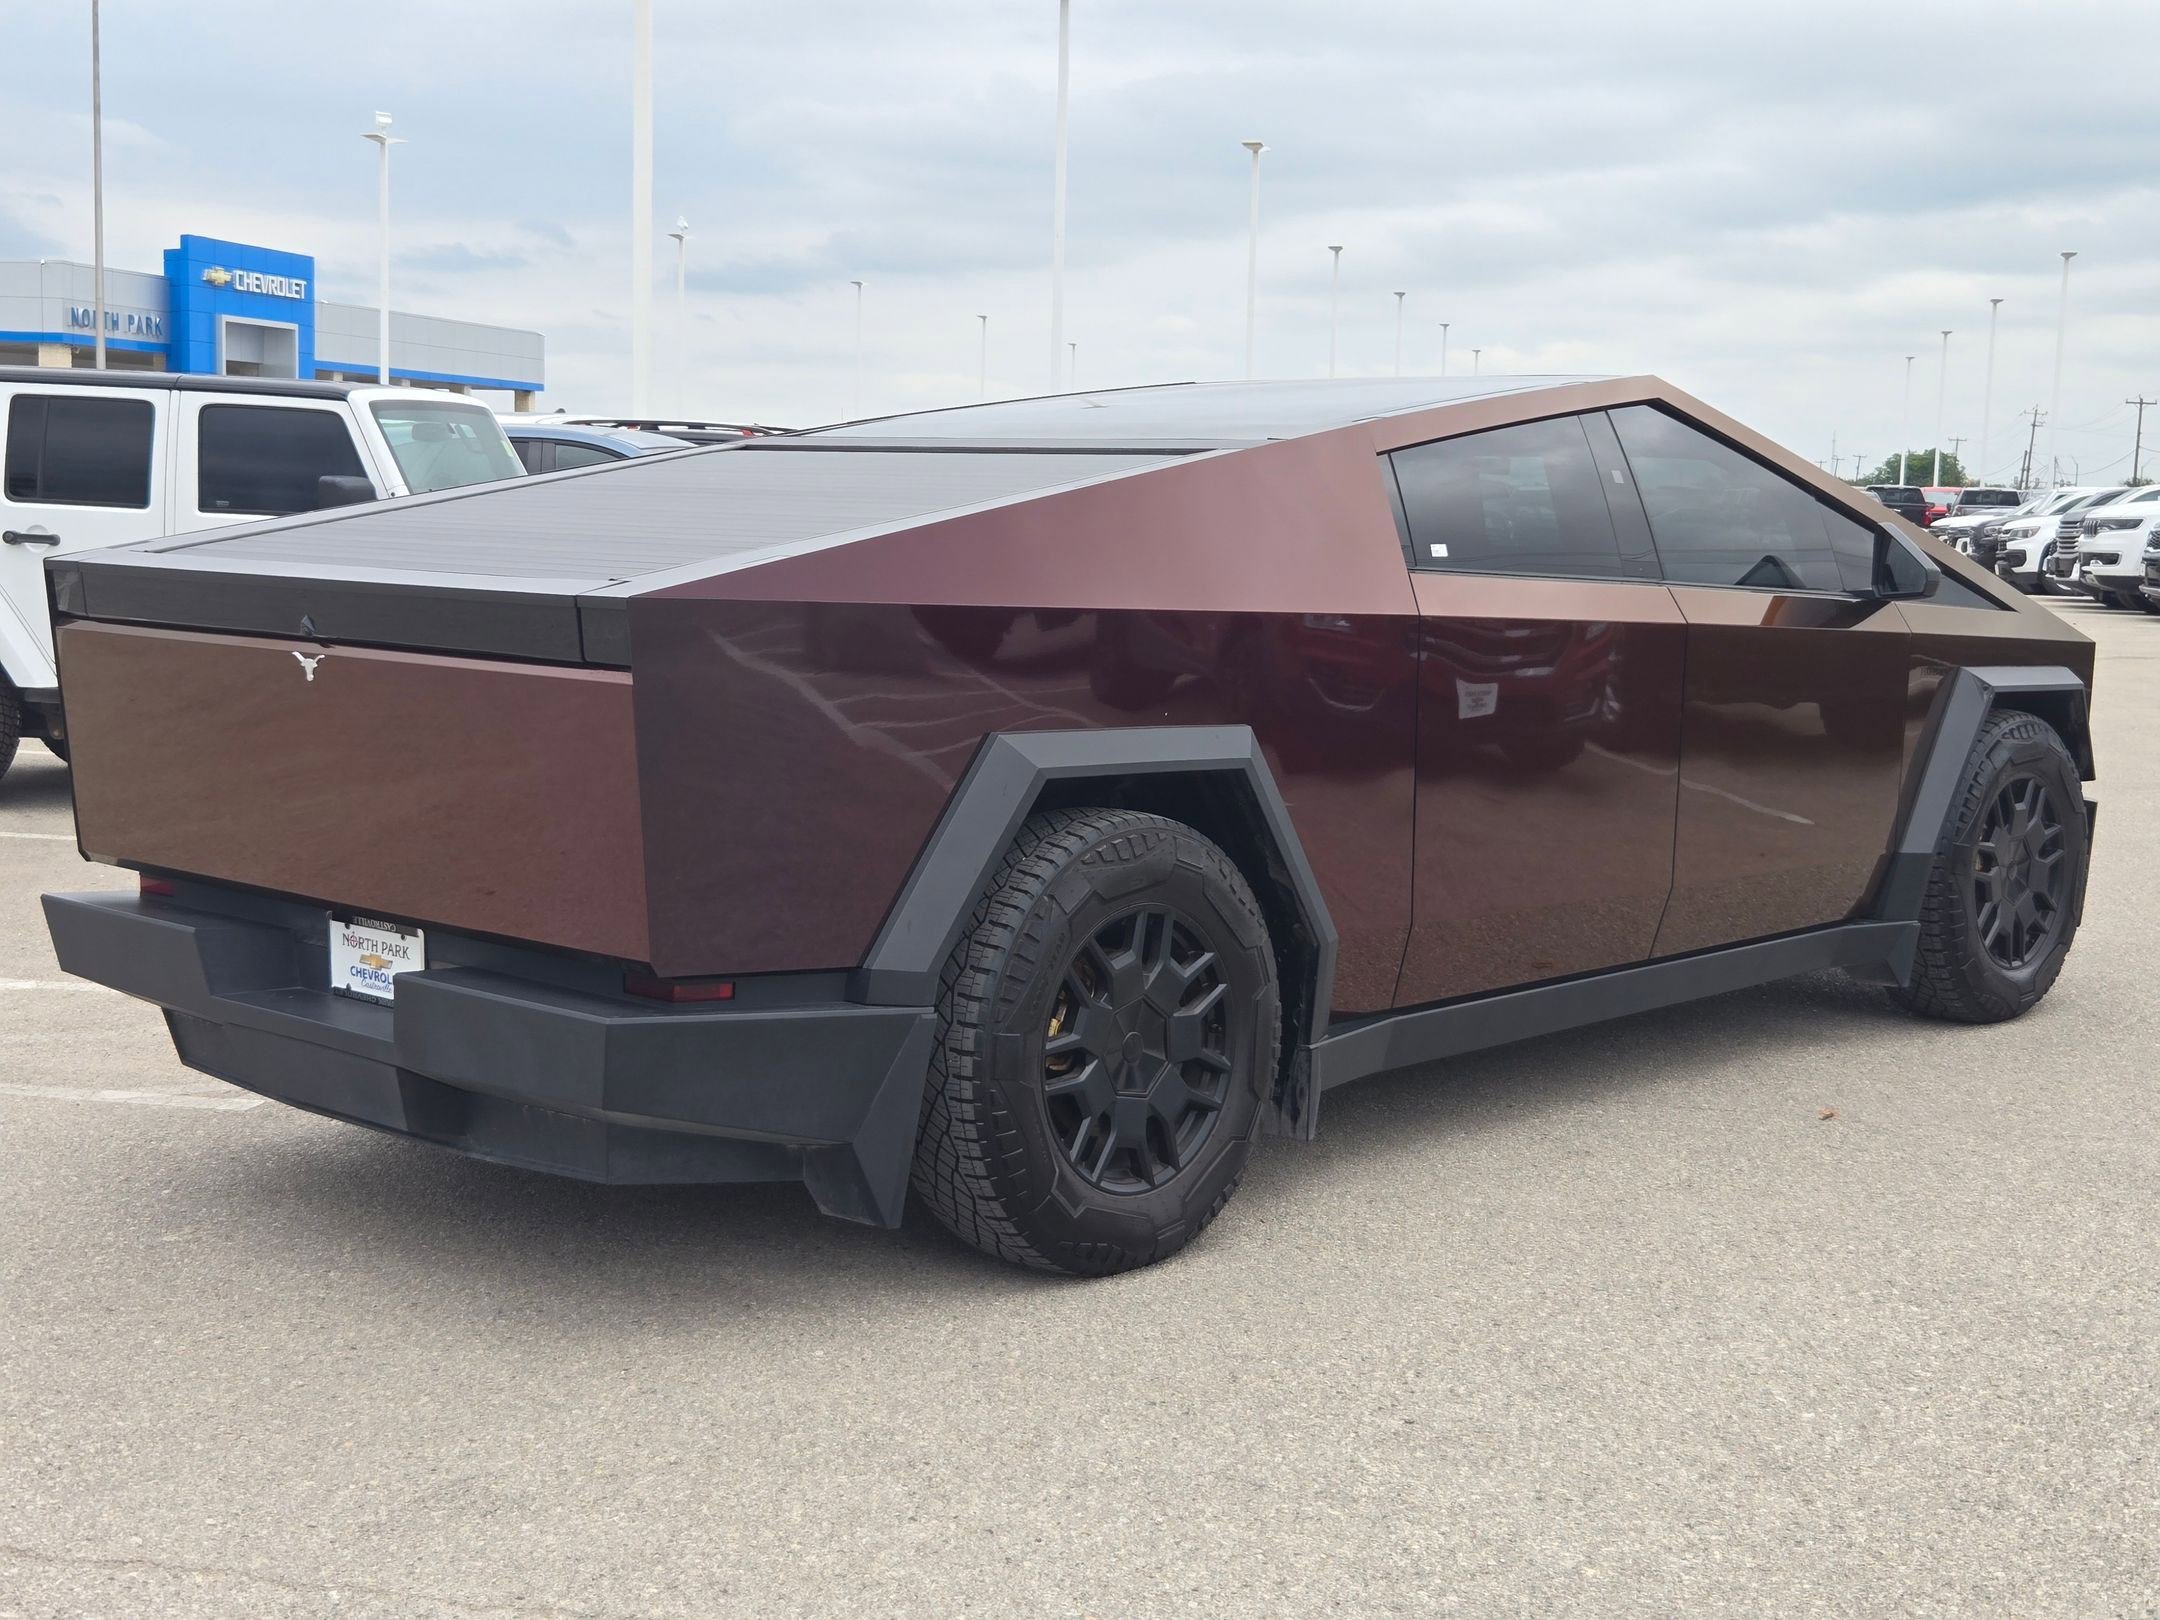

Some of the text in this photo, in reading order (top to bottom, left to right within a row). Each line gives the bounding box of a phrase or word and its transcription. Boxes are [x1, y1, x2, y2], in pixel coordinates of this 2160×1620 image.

[233, 270, 307, 299] CHEVROLET
[127, 314, 162, 338] PARK
[342, 931, 410, 960] NORTH PARK
[350, 965, 393, 985] CHEVROL
